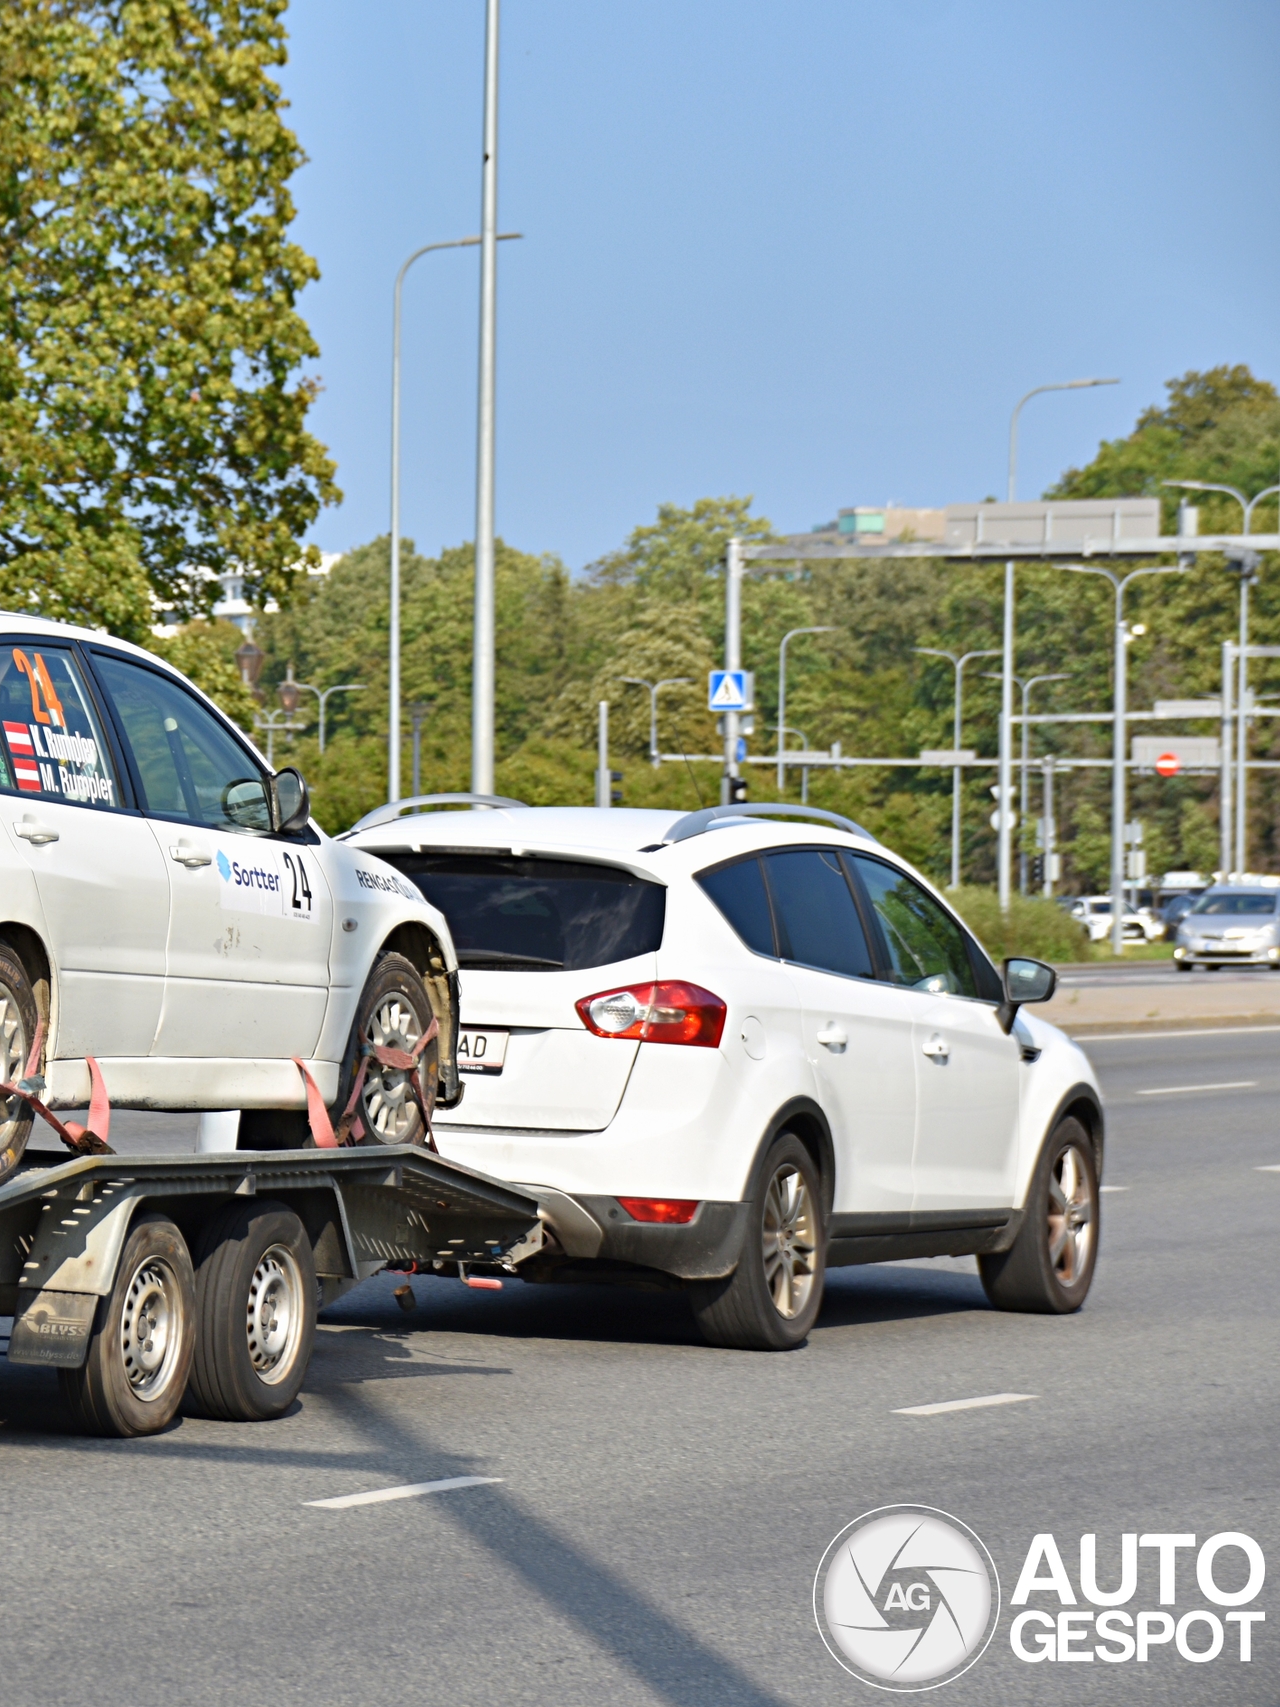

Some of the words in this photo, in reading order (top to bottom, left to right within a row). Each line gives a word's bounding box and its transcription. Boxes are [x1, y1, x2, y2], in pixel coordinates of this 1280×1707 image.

[12, 648, 64, 727] 24
[29, 724, 48, 758] K.
[39, 762, 59, 793] M.
[58, 765, 114, 804] Rumpler
[232, 861, 279, 892] Sortter
[283, 852, 312, 911] 24
[40, 1323, 86, 1337] BLYSS
